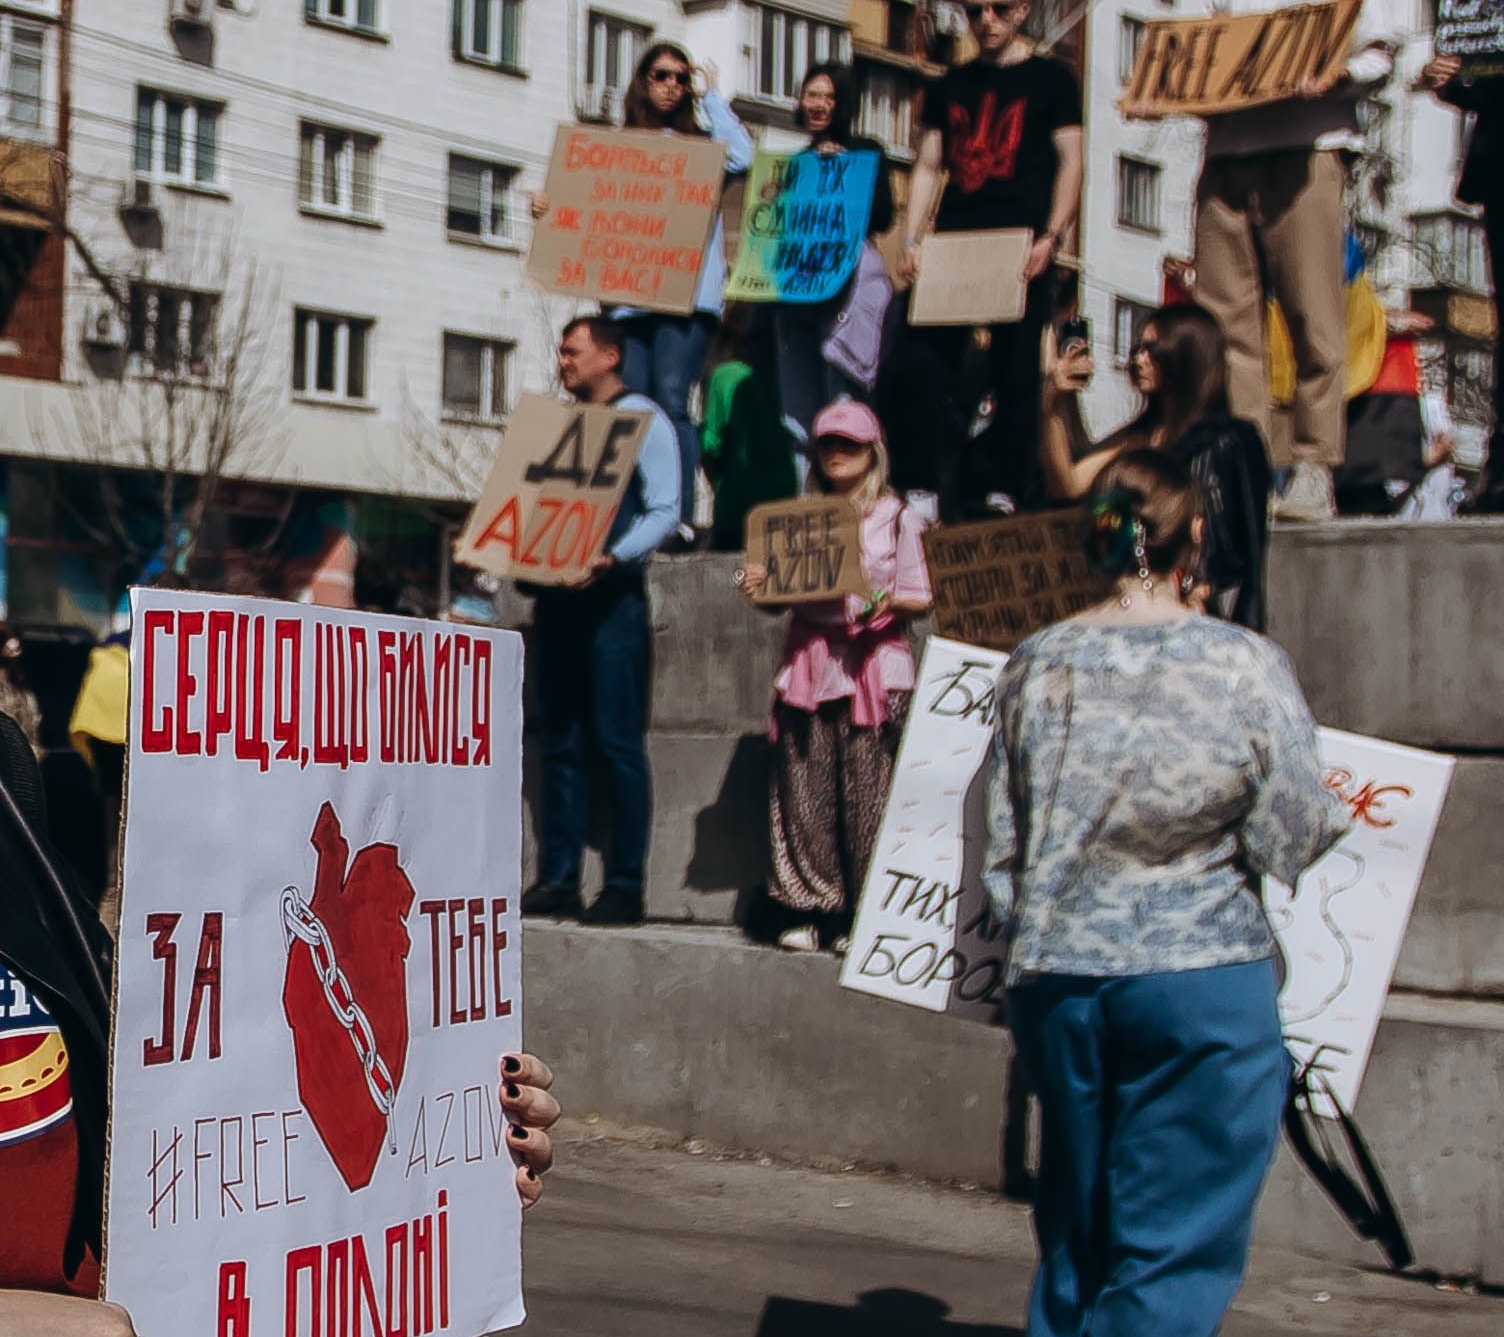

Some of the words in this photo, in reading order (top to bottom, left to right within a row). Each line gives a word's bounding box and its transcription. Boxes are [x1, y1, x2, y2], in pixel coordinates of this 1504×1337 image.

[1129, 22, 1230, 101] FREE
[524, 413, 641, 489] ДЕ
[473, 494, 618, 570] AZOV
[764, 545, 846, 595] AZOV
[765, 511, 842, 551] FREE
[141, 610, 310, 772] СЕРЦЯ,
[314, 621, 369, 770] ЩО
[378, 630, 492, 766] БИЛИСЯ
[143, 912, 223, 1065] ЗА
[420, 898, 512, 1029] ТЕБЕ
[148, 1109, 306, 1230] #FREE
[405, 1084, 504, 1180] AZOV
